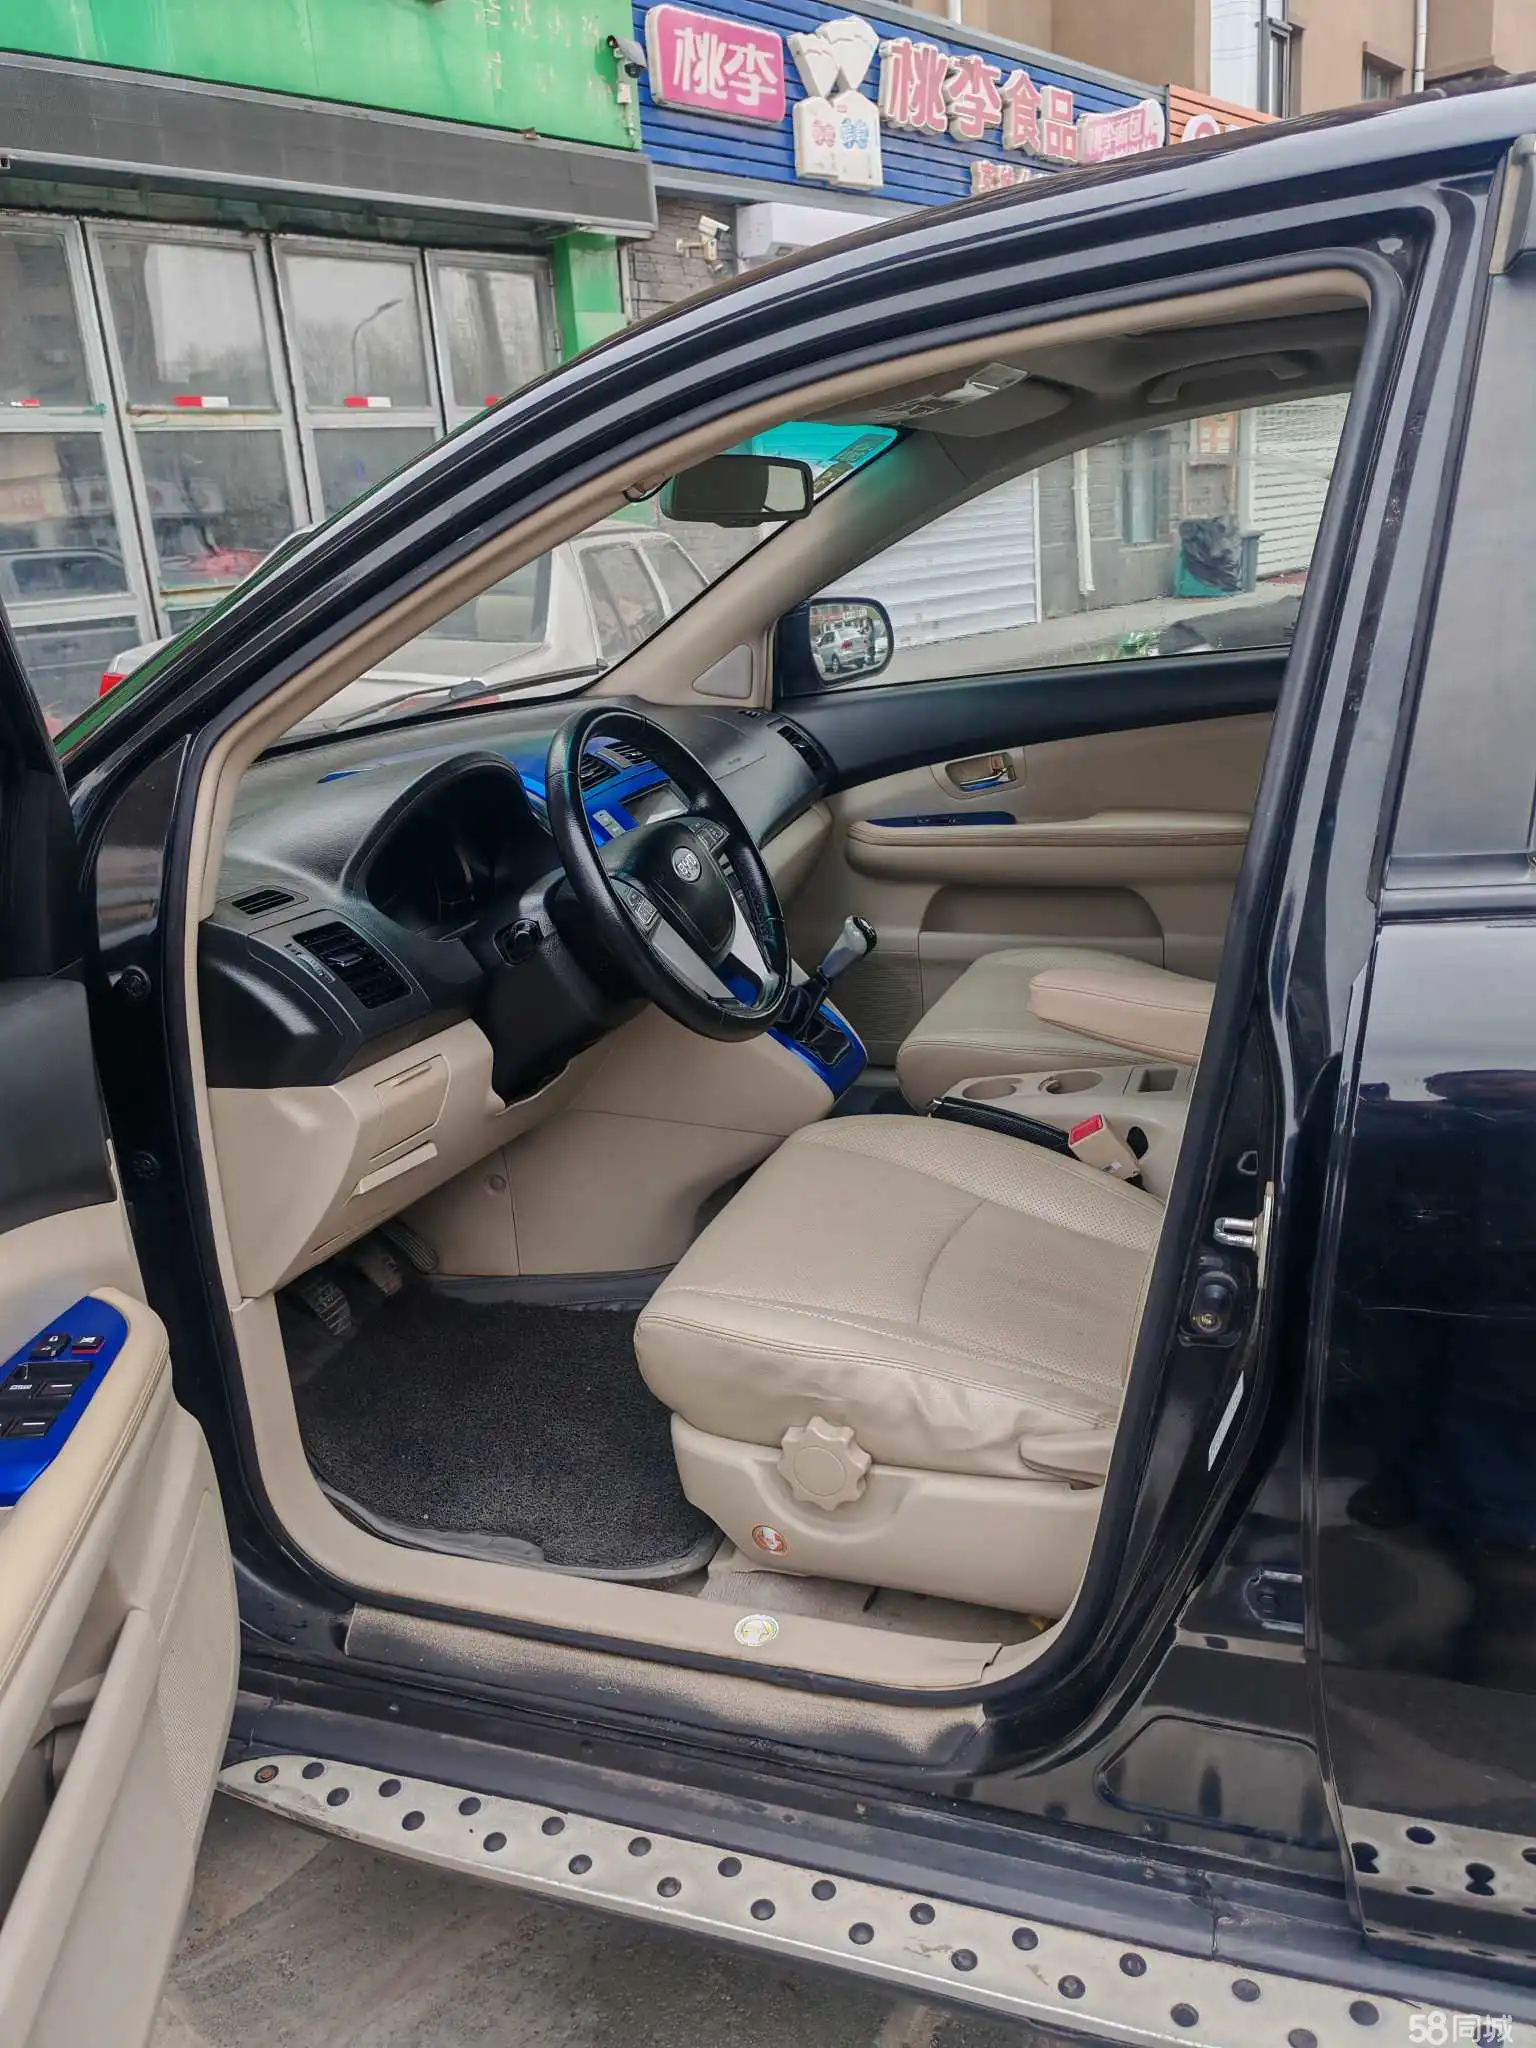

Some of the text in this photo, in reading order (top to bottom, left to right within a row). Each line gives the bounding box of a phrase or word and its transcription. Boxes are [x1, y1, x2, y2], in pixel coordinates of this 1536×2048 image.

[672, 27, 779, 106] 桃李
[885, 38, 1079, 163] 桃李食品
